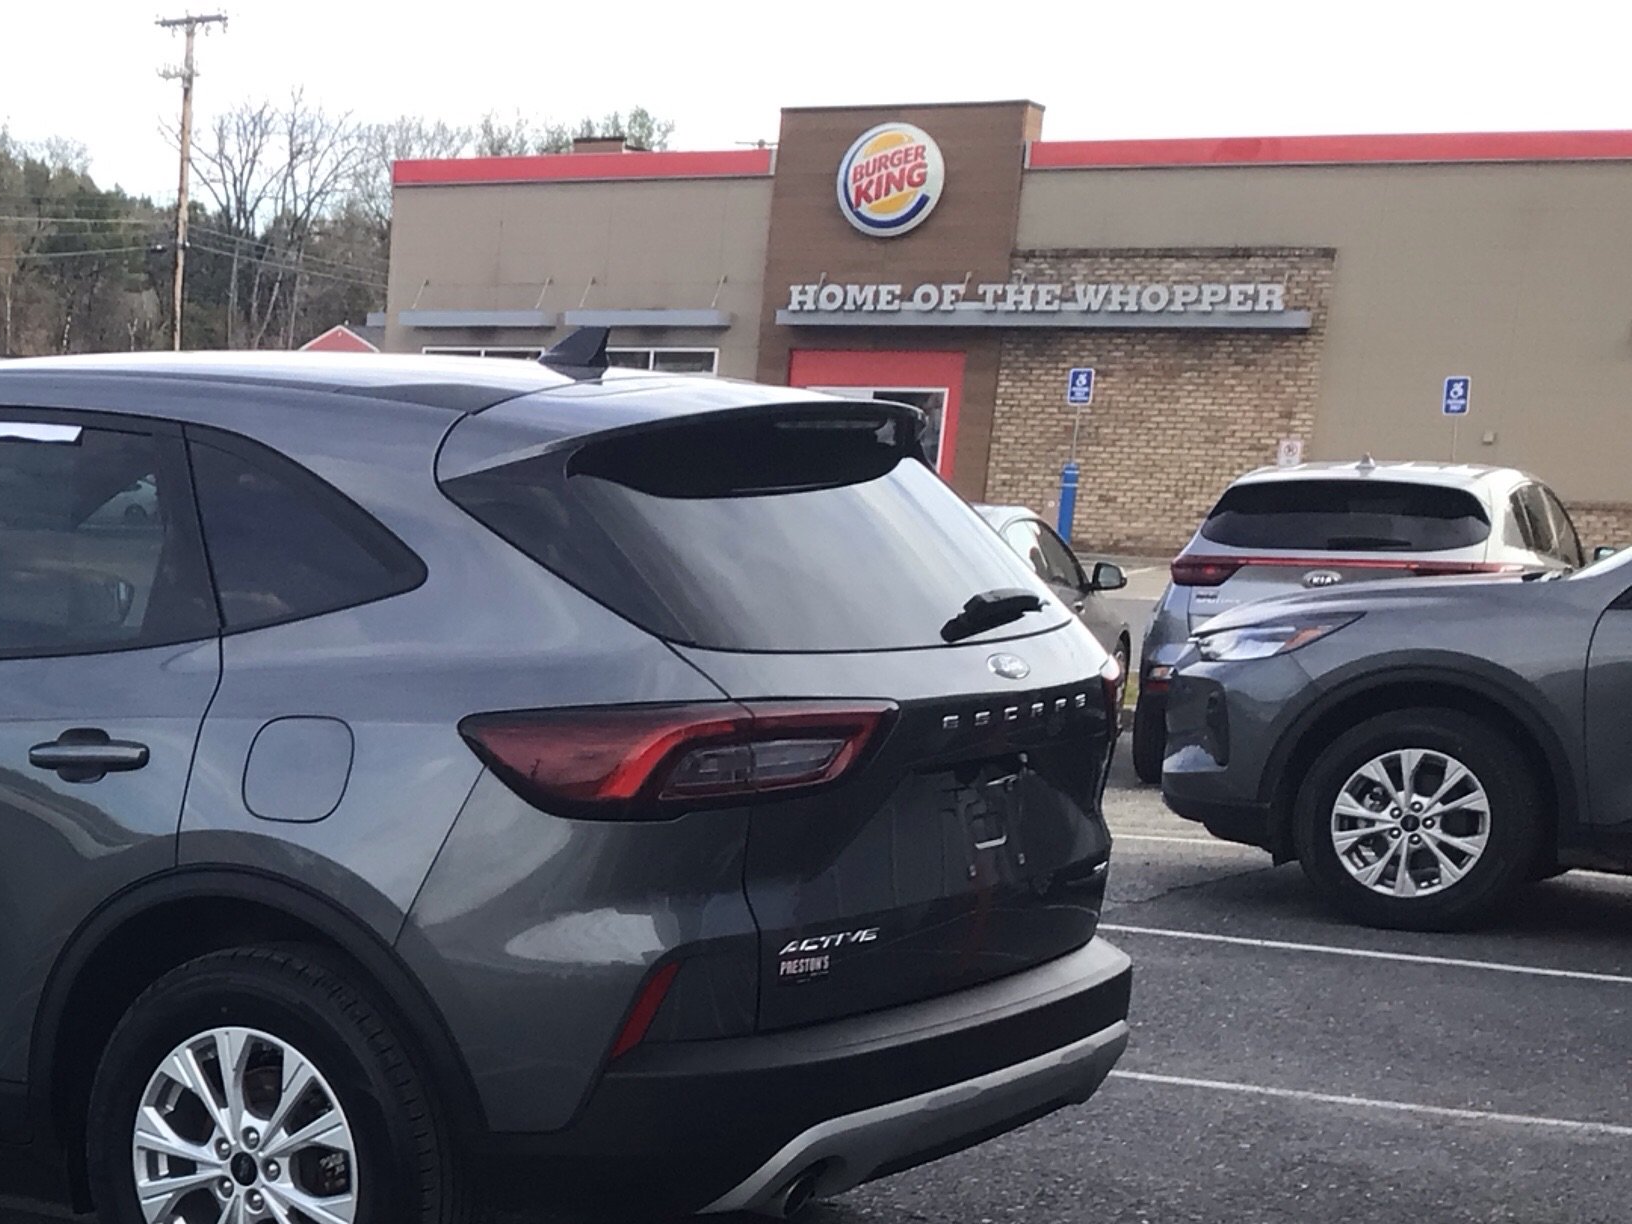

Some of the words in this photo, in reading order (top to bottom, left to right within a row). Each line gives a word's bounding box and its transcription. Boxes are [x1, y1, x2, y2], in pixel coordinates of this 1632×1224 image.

[852, 145, 927, 184] BURGER
[853, 162, 928, 209] KING
[788, 284, 902, 311] HOME
[913, 284, 966, 311] OF
[978, 284, 1062, 311] THE
[1074, 283, 1285, 312] WHOPPER
[1312, 576, 1333, 585] KIA
